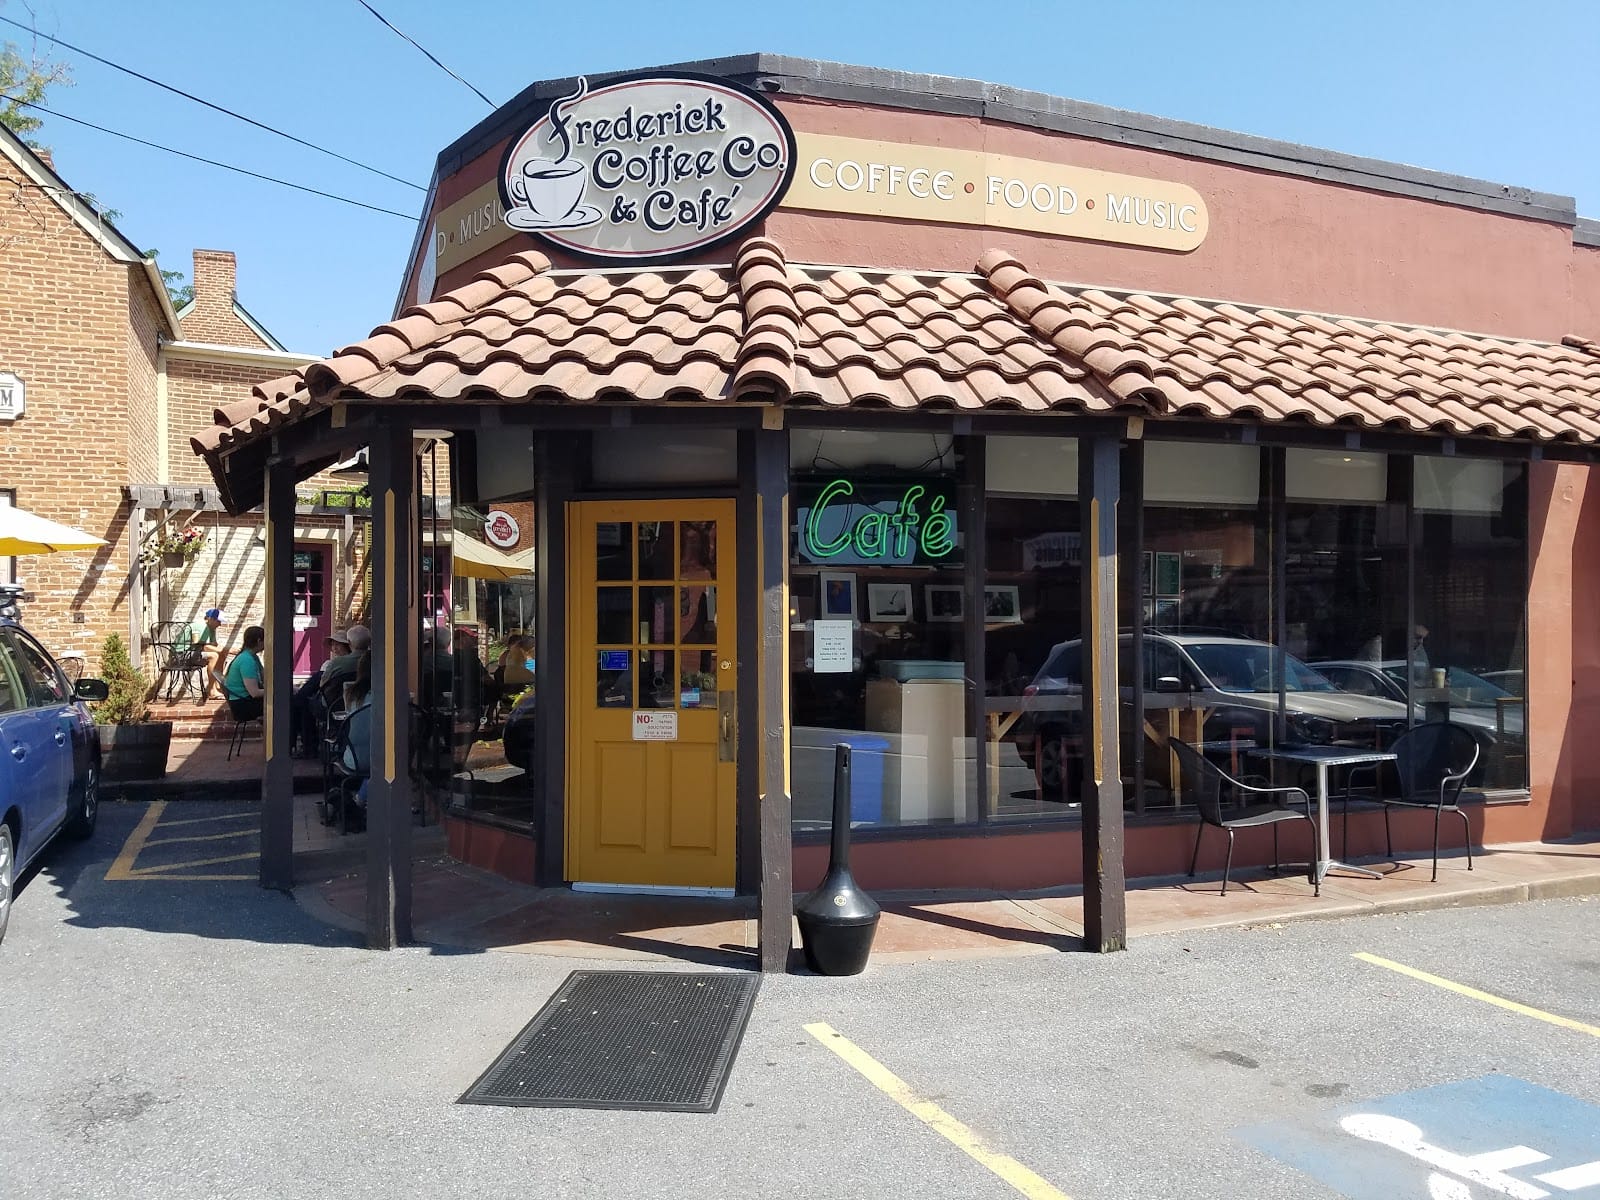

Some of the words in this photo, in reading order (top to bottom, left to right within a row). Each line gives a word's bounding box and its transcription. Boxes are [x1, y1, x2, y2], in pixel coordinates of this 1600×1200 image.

[548, 79, 726, 164] Frederick
[592, 146, 716, 188] Coffee
[723, 137, 785, 178] Co.
[611, 197, 637, 226] &
[809, 157, 955, 200] COFFEE
[986, 176, 1079, 216] FOOD
[1105, 193, 1198, 233] MUSIC
[808, 479, 953, 557] Café
[636, 714, 654, 724] NO:
